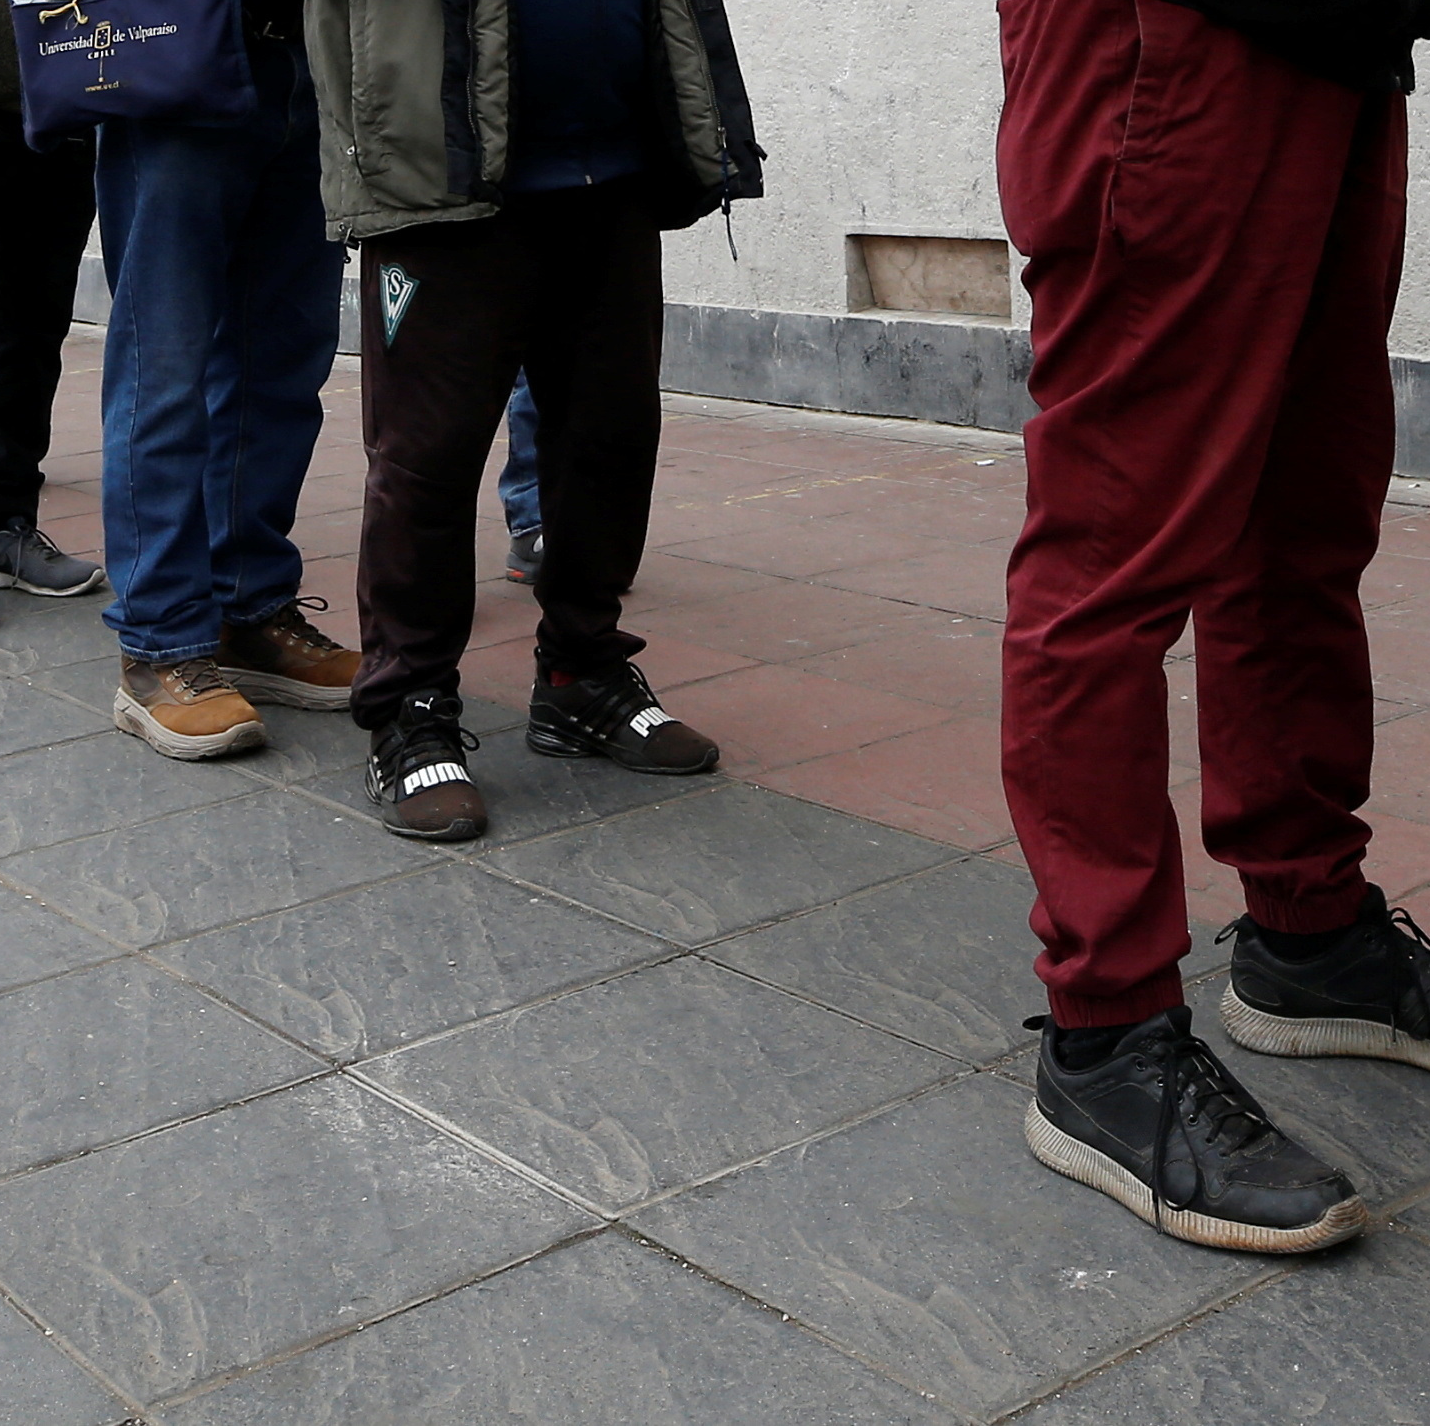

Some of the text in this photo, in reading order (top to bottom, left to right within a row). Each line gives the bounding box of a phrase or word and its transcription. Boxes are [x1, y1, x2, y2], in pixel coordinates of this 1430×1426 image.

[39, 34, 94, 56] Universidad
[112, 29, 126, 43] de
[88, 49, 116, 60] CHILE
